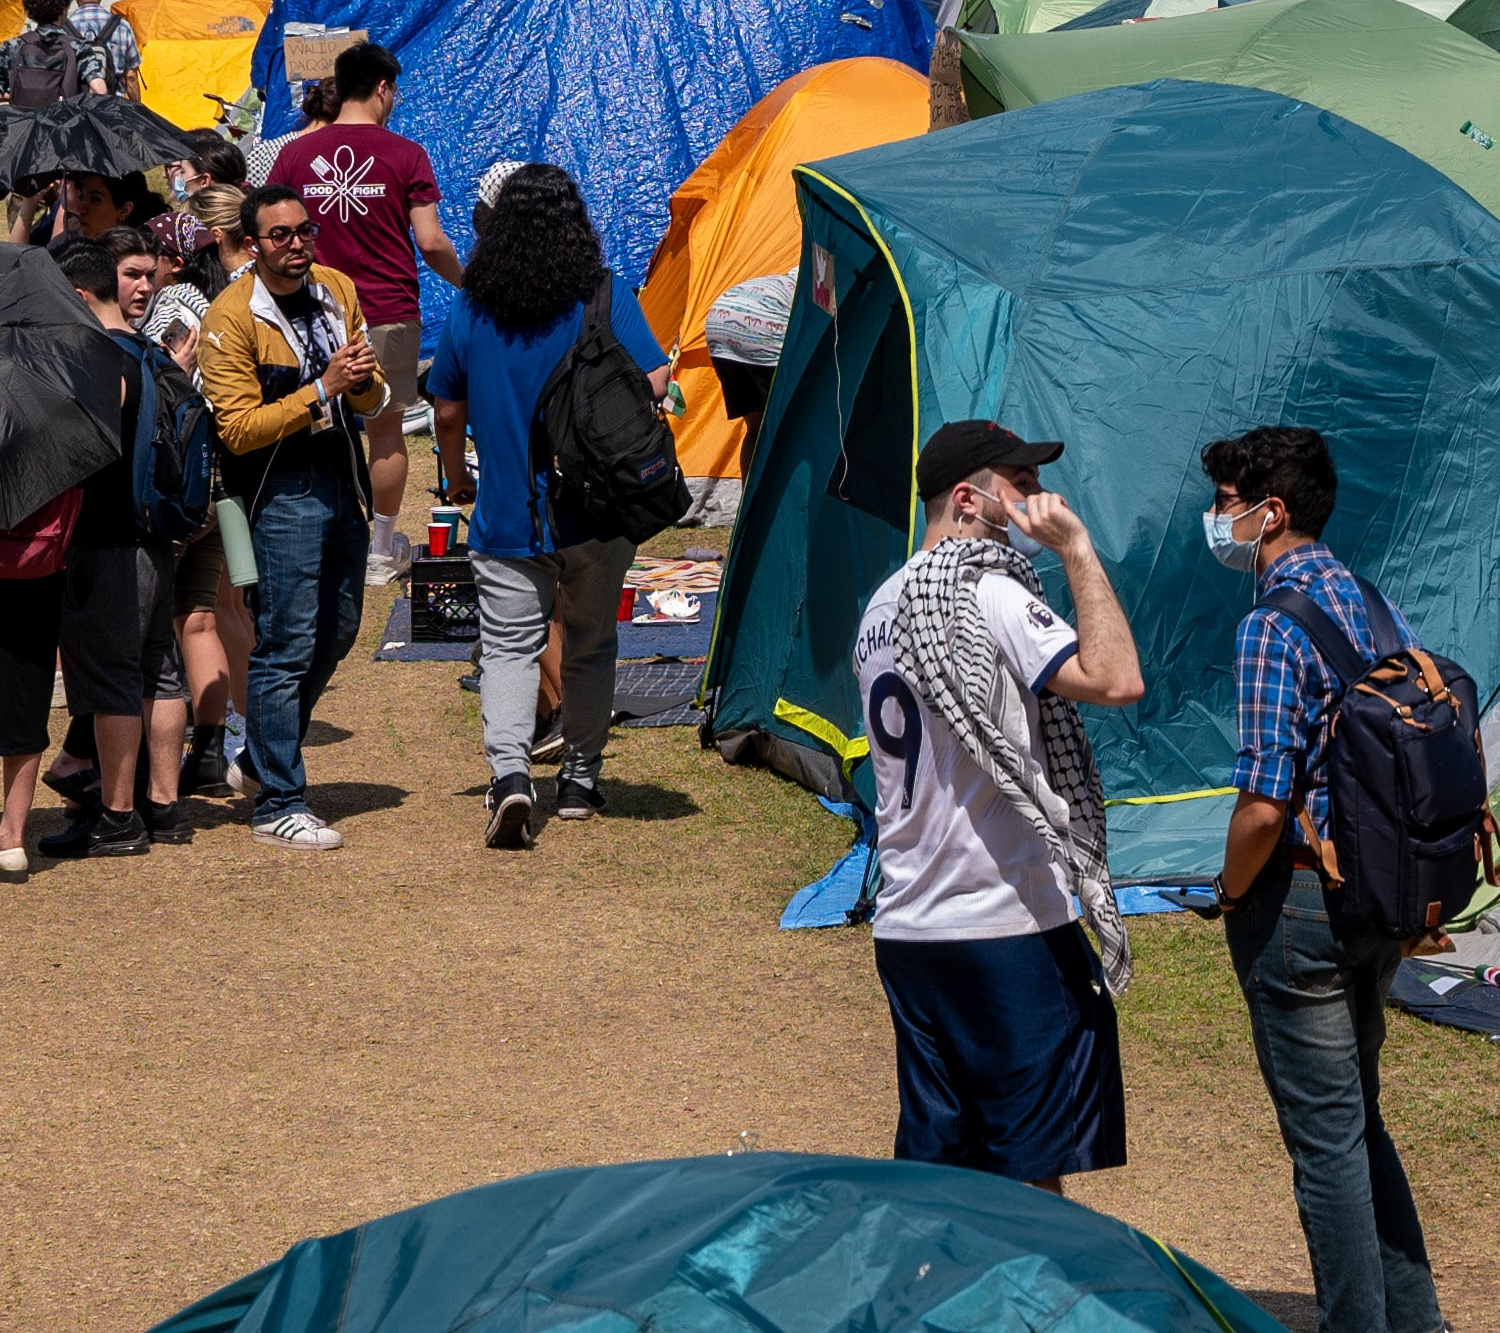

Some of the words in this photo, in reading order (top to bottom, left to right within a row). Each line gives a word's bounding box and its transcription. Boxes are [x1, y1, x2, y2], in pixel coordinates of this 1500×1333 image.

[288, 41, 337, 55] WALID
[303, 186, 333, 197] FOOD
[352, 186, 386, 197] FIGHT
[868, 669, 924, 811] 9
